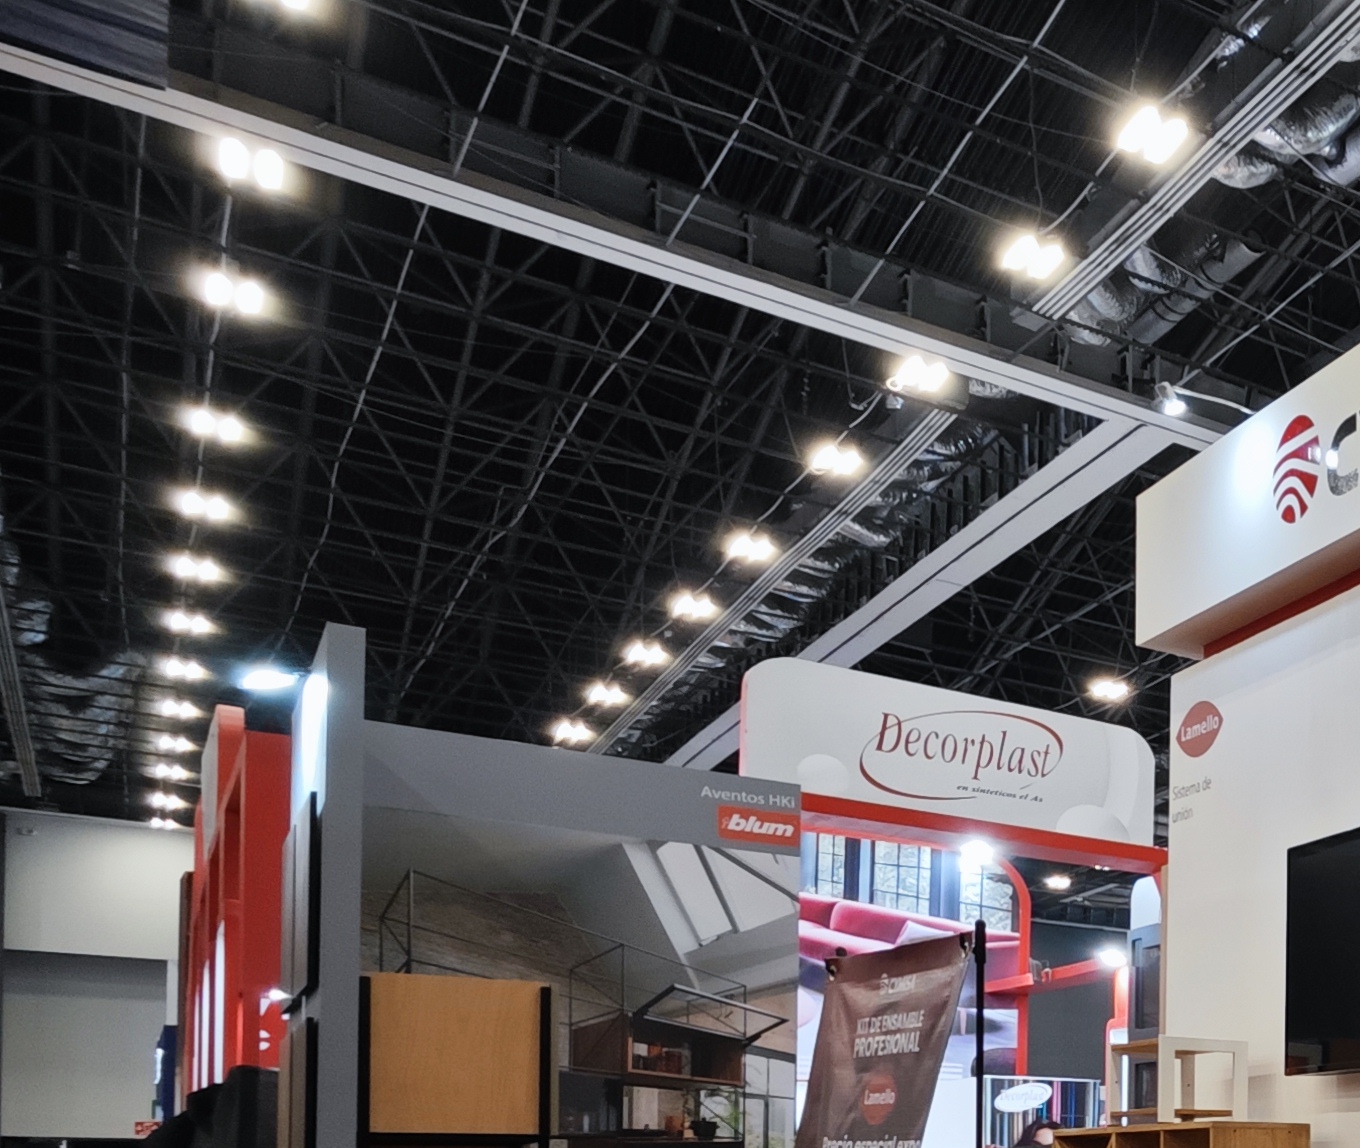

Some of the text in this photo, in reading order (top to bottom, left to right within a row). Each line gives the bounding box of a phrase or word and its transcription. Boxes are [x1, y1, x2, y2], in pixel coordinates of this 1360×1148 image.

[1181, 714, 1220, 742] Lamello
[875, 712, 1051, 781] Decorplast
[700, 785, 796, 809] Aventos HKi
[1172, 776, 1213, 801] Sistema de
[727, 813, 795, 838] blum
[1172, 807, 1194, 824] unión
[869, 1016, 882, 1034] DE
[853, 1031, 920, 1058] PROFESIONAL
[863, 1089, 896, 1107] Lamello
